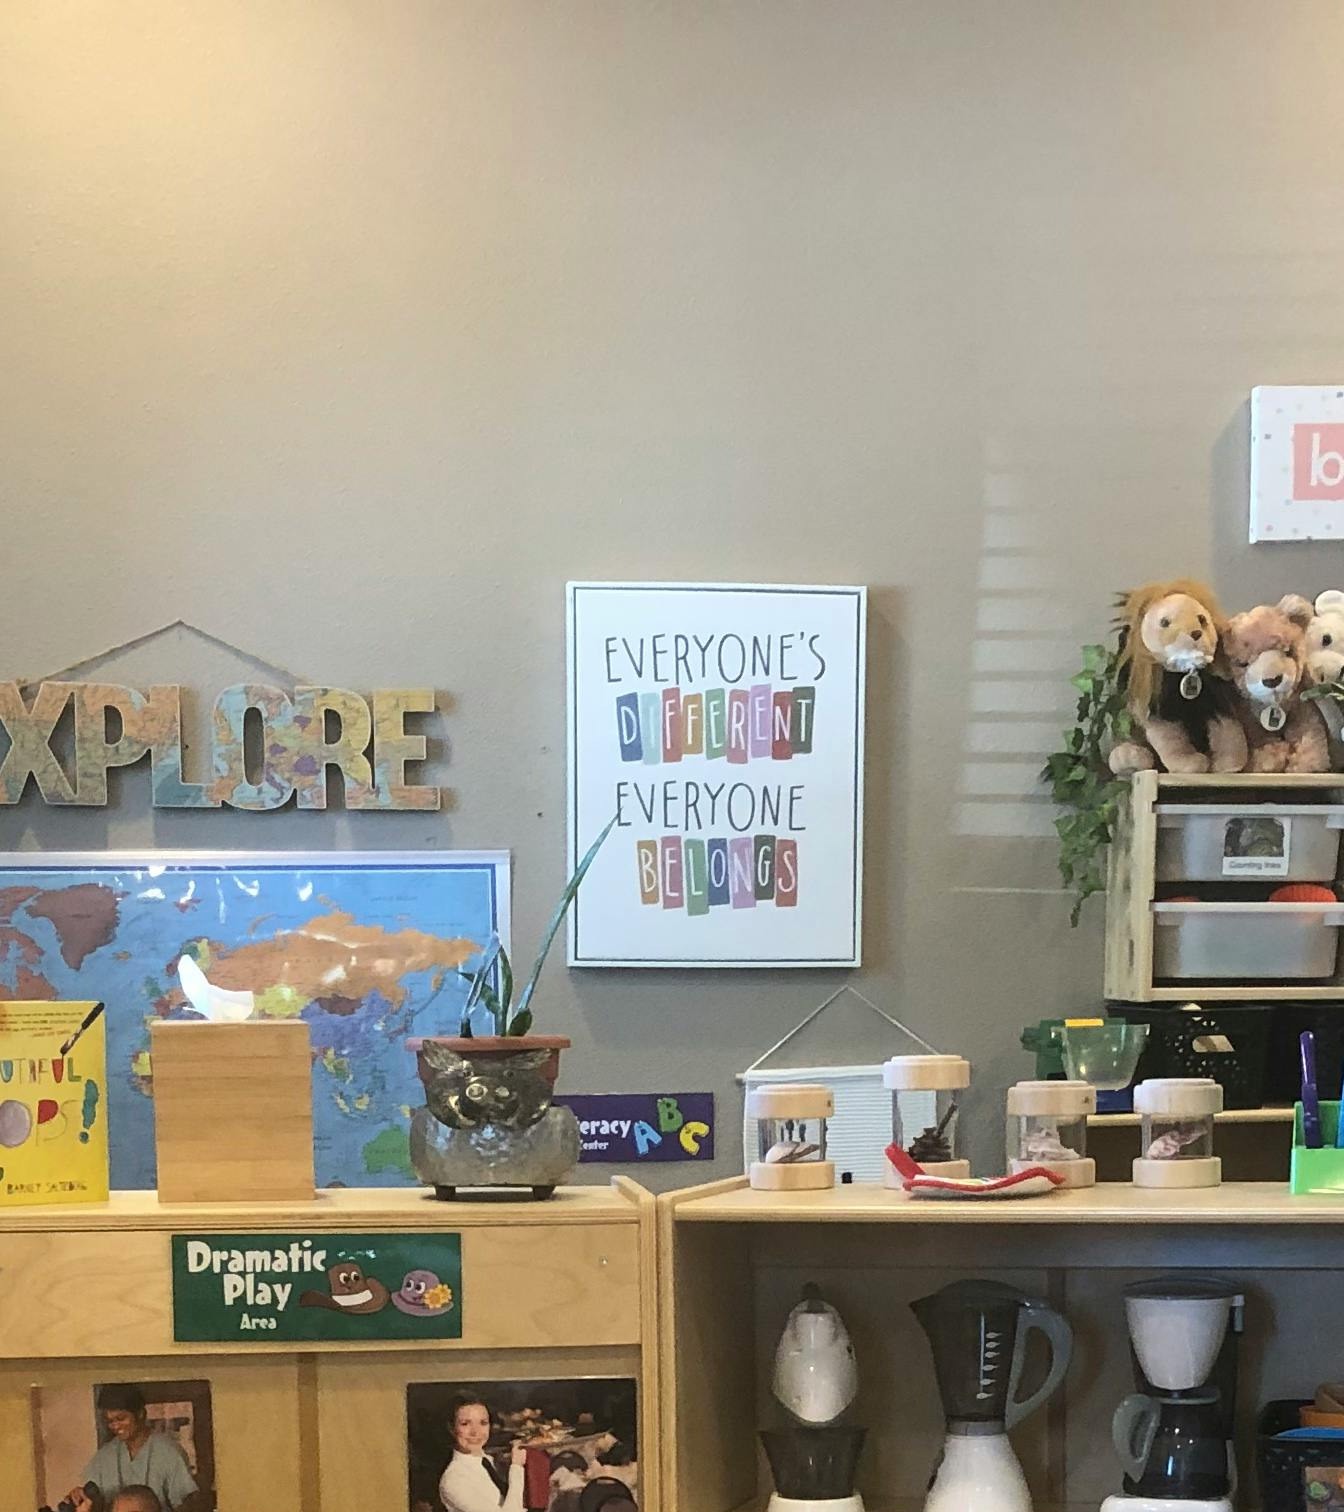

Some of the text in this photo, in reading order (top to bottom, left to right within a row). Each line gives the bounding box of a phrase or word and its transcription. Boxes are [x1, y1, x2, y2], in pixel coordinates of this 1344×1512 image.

[605, 631, 826, 685] EVERYONE'S
[620, 696, 813, 750] DIFFERENT
[616, 780, 806, 832] EVERYONE
[640, 845, 796, 897] BELONGS
[576, 1116, 631, 1138] eracy
[580, 1139, 609, 1151] enter
[186, 1239, 327, 1273] Dramatic
[223, 1273, 293, 1311] Play
[240, 1313, 277, 1330] Area
